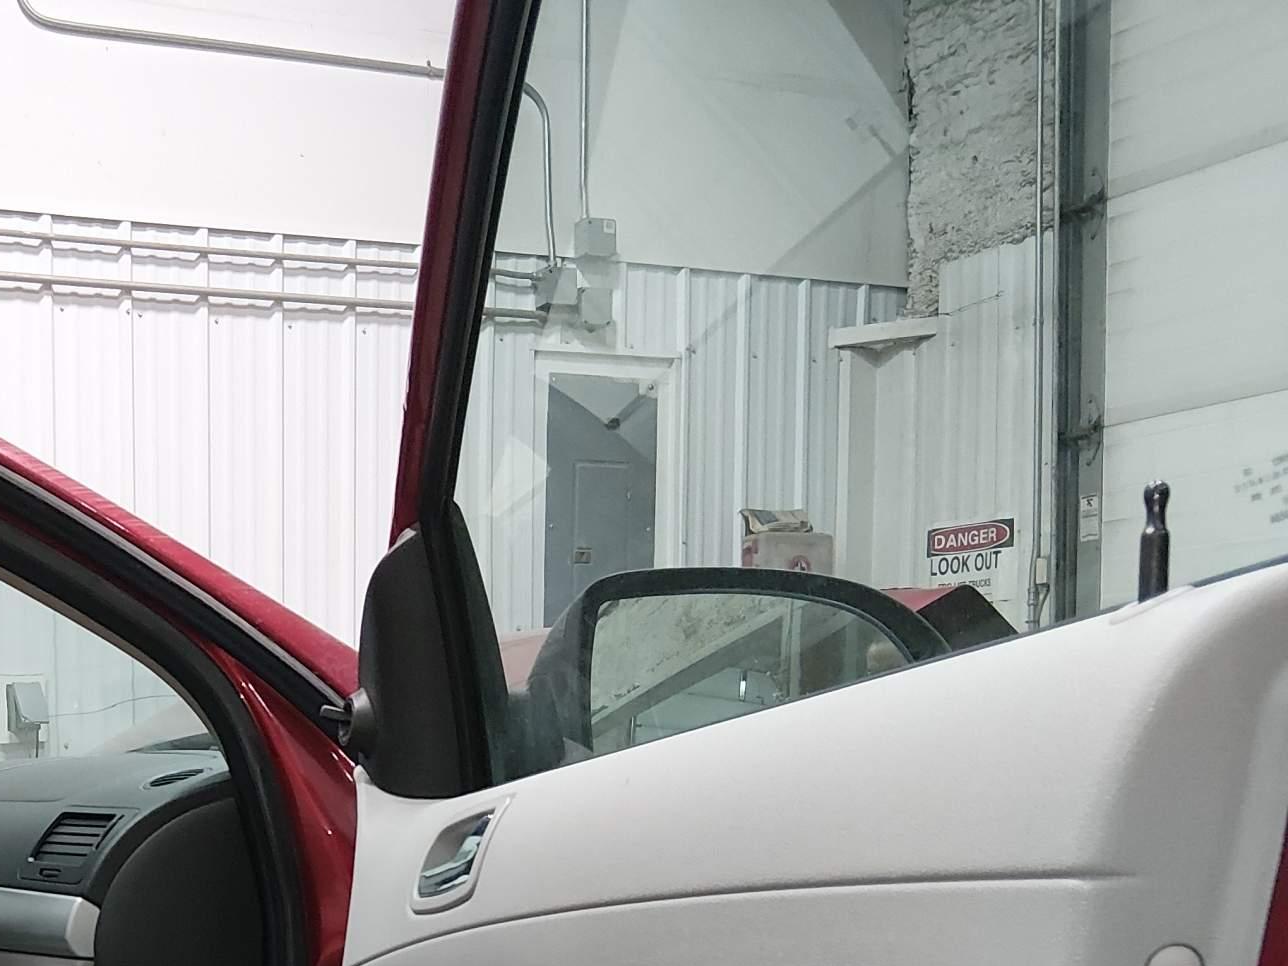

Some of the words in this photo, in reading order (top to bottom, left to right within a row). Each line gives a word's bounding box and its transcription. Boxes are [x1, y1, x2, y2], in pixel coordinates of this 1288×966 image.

[934, 529, 997, 549] DANGER
[931, 555, 970, 576] LOOK
[975, 551, 1002, 571] OUT
